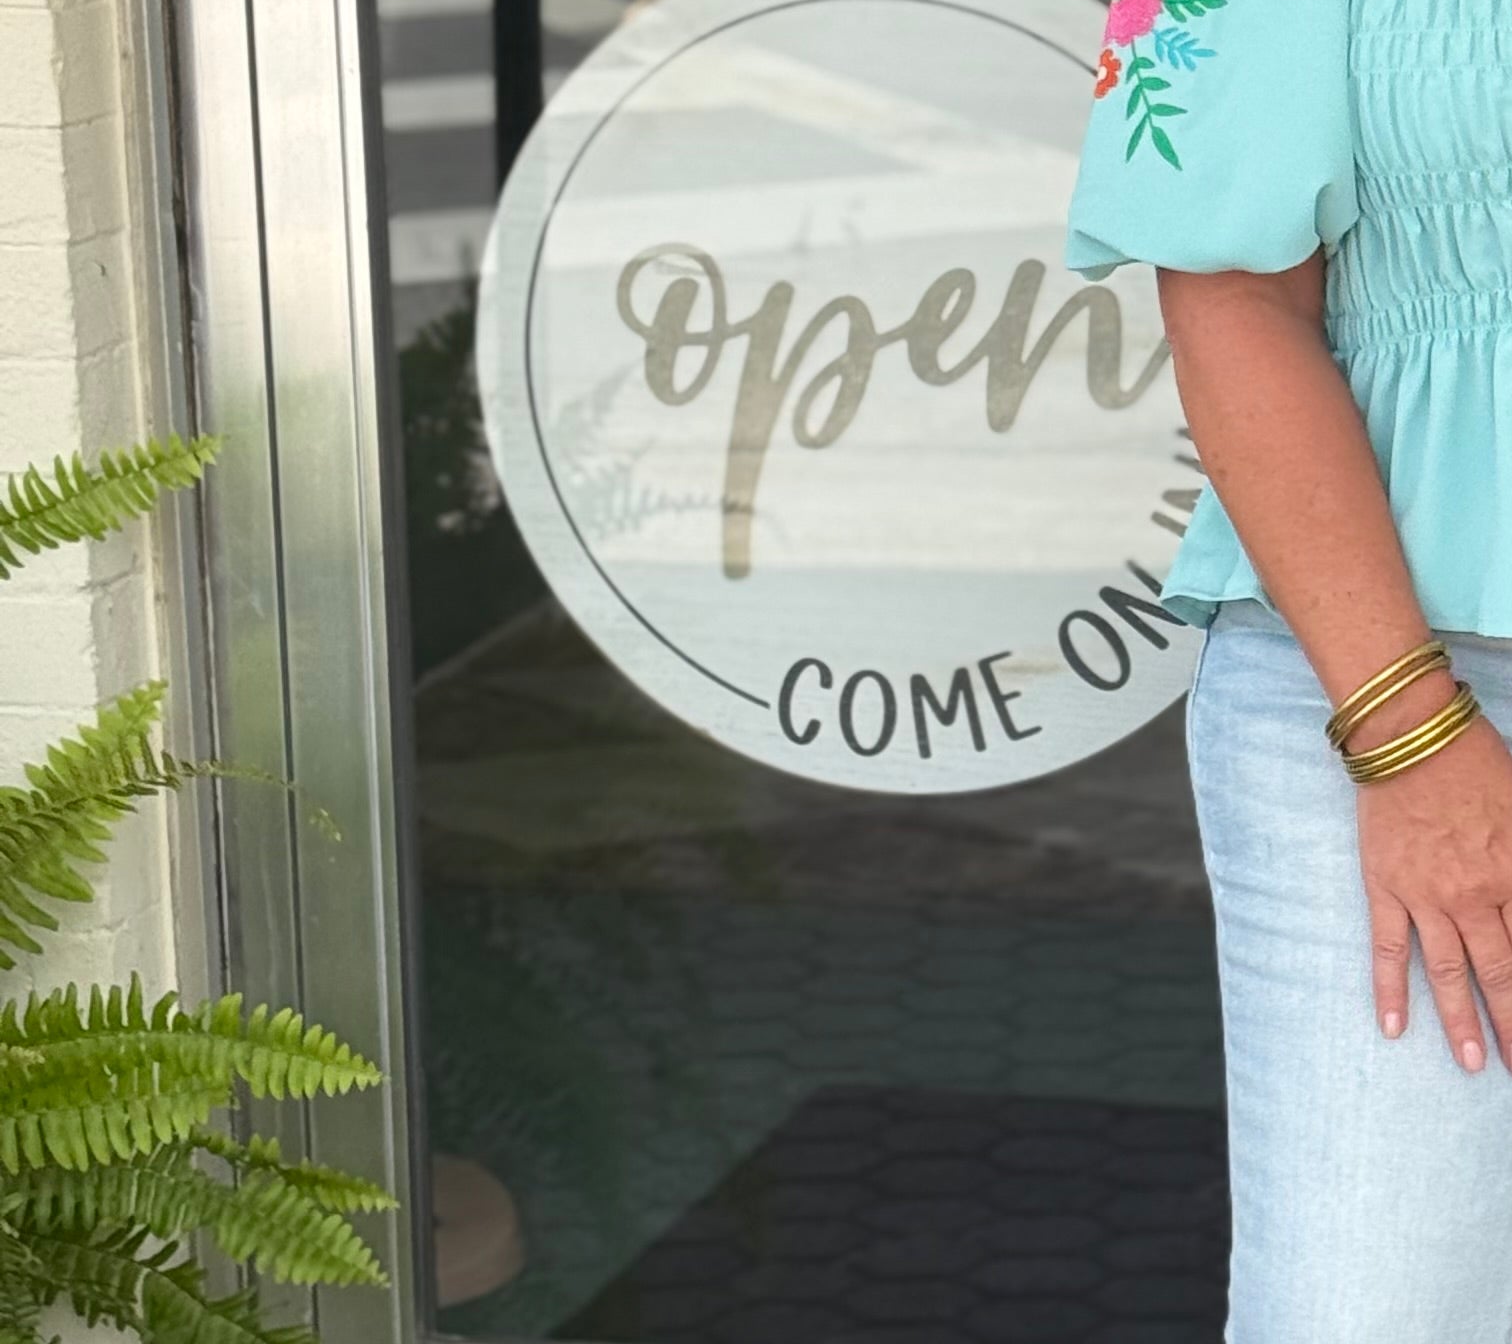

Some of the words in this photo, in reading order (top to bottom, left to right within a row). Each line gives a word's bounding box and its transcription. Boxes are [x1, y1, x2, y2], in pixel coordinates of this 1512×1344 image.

[615, 242, 1174, 580] open
[777, 650, 1044, 760] COME
[1057, 558, 1191, 693] ON
